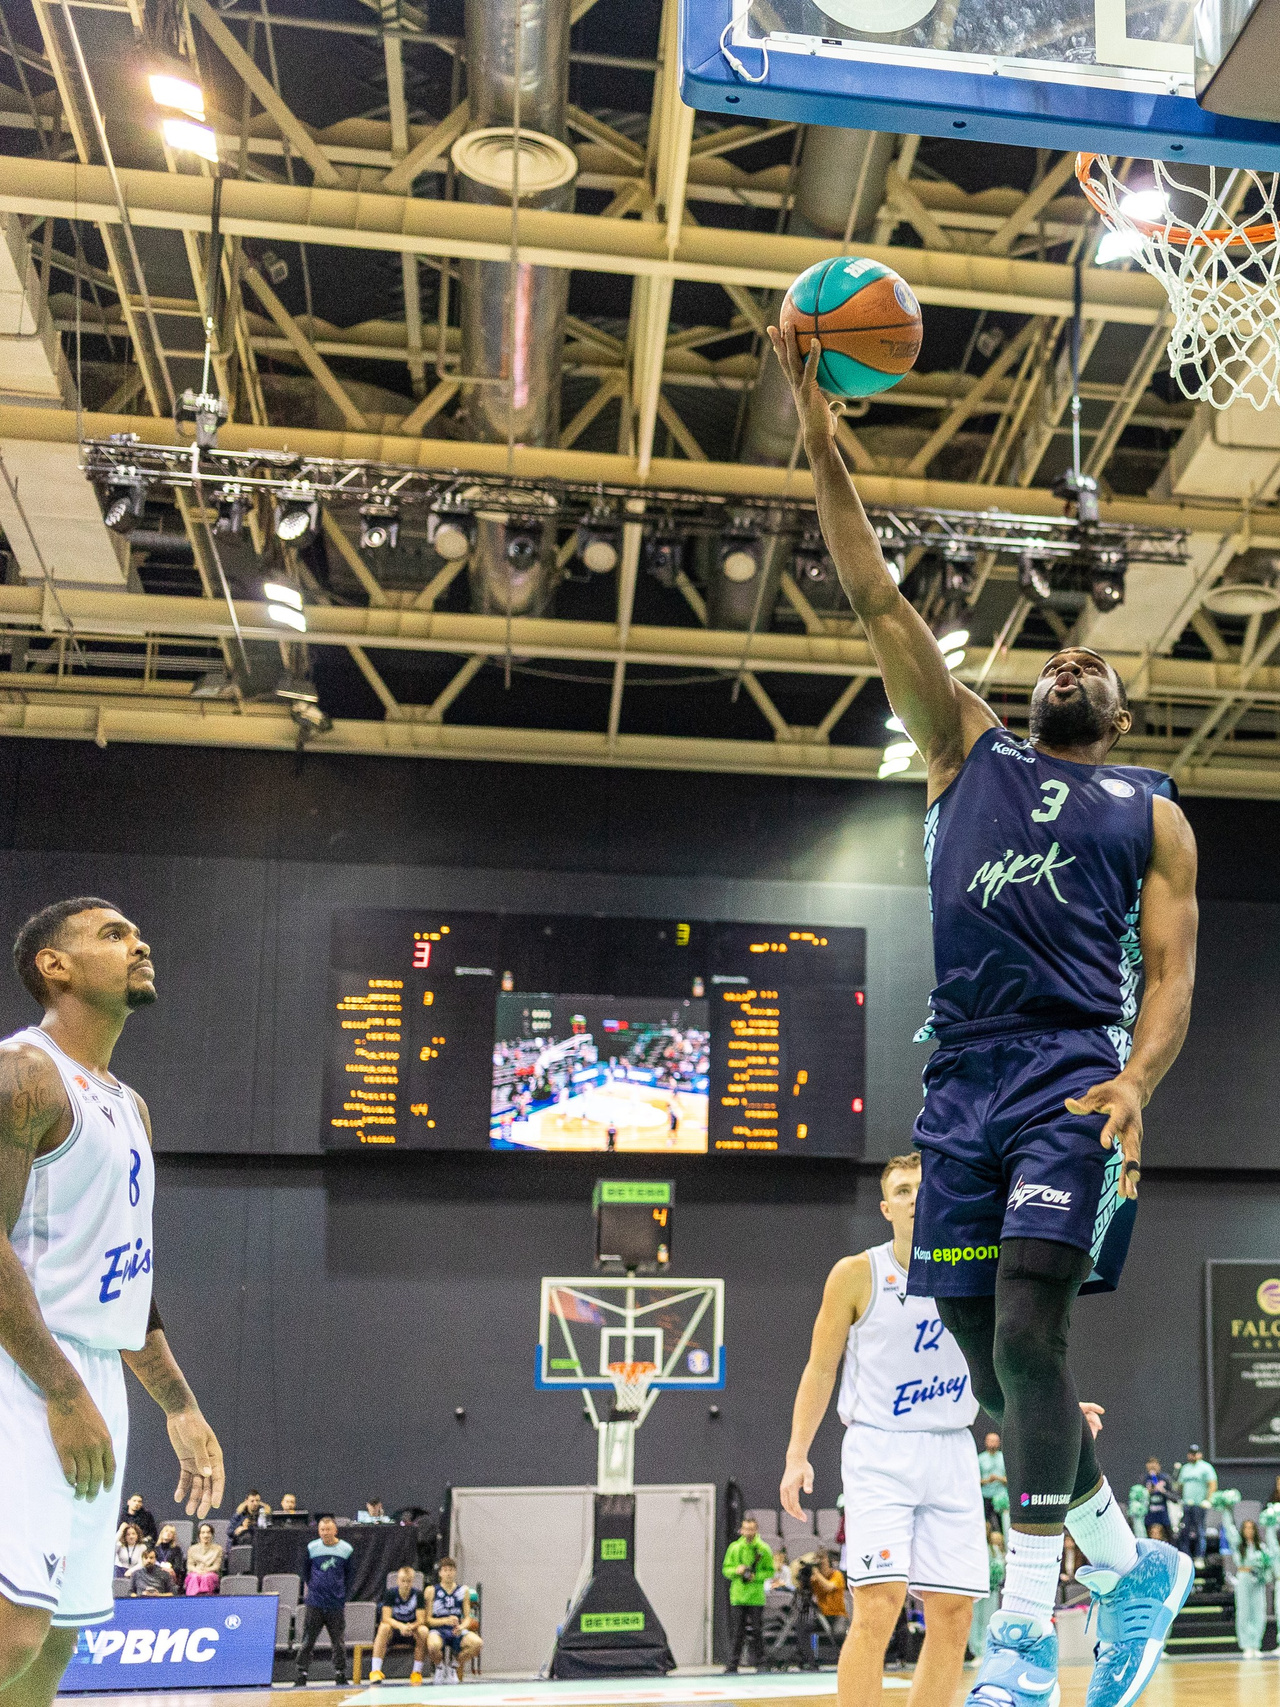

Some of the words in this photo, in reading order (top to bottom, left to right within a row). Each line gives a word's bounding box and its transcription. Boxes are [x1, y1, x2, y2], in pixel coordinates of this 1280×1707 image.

[991, 741, 1036, 763] Kempa
[1031, 779, 1070, 823] 3
[412, 941, 431, 968] 3
[653, 1208, 668, 1226] 4
[99, 1237, 151, 1303] Enis
[932, 1245, 1003, 1267] еврооп
[914, 1319, 945, 1353] 12
[893, 1374, 968, 1416] Enisey
